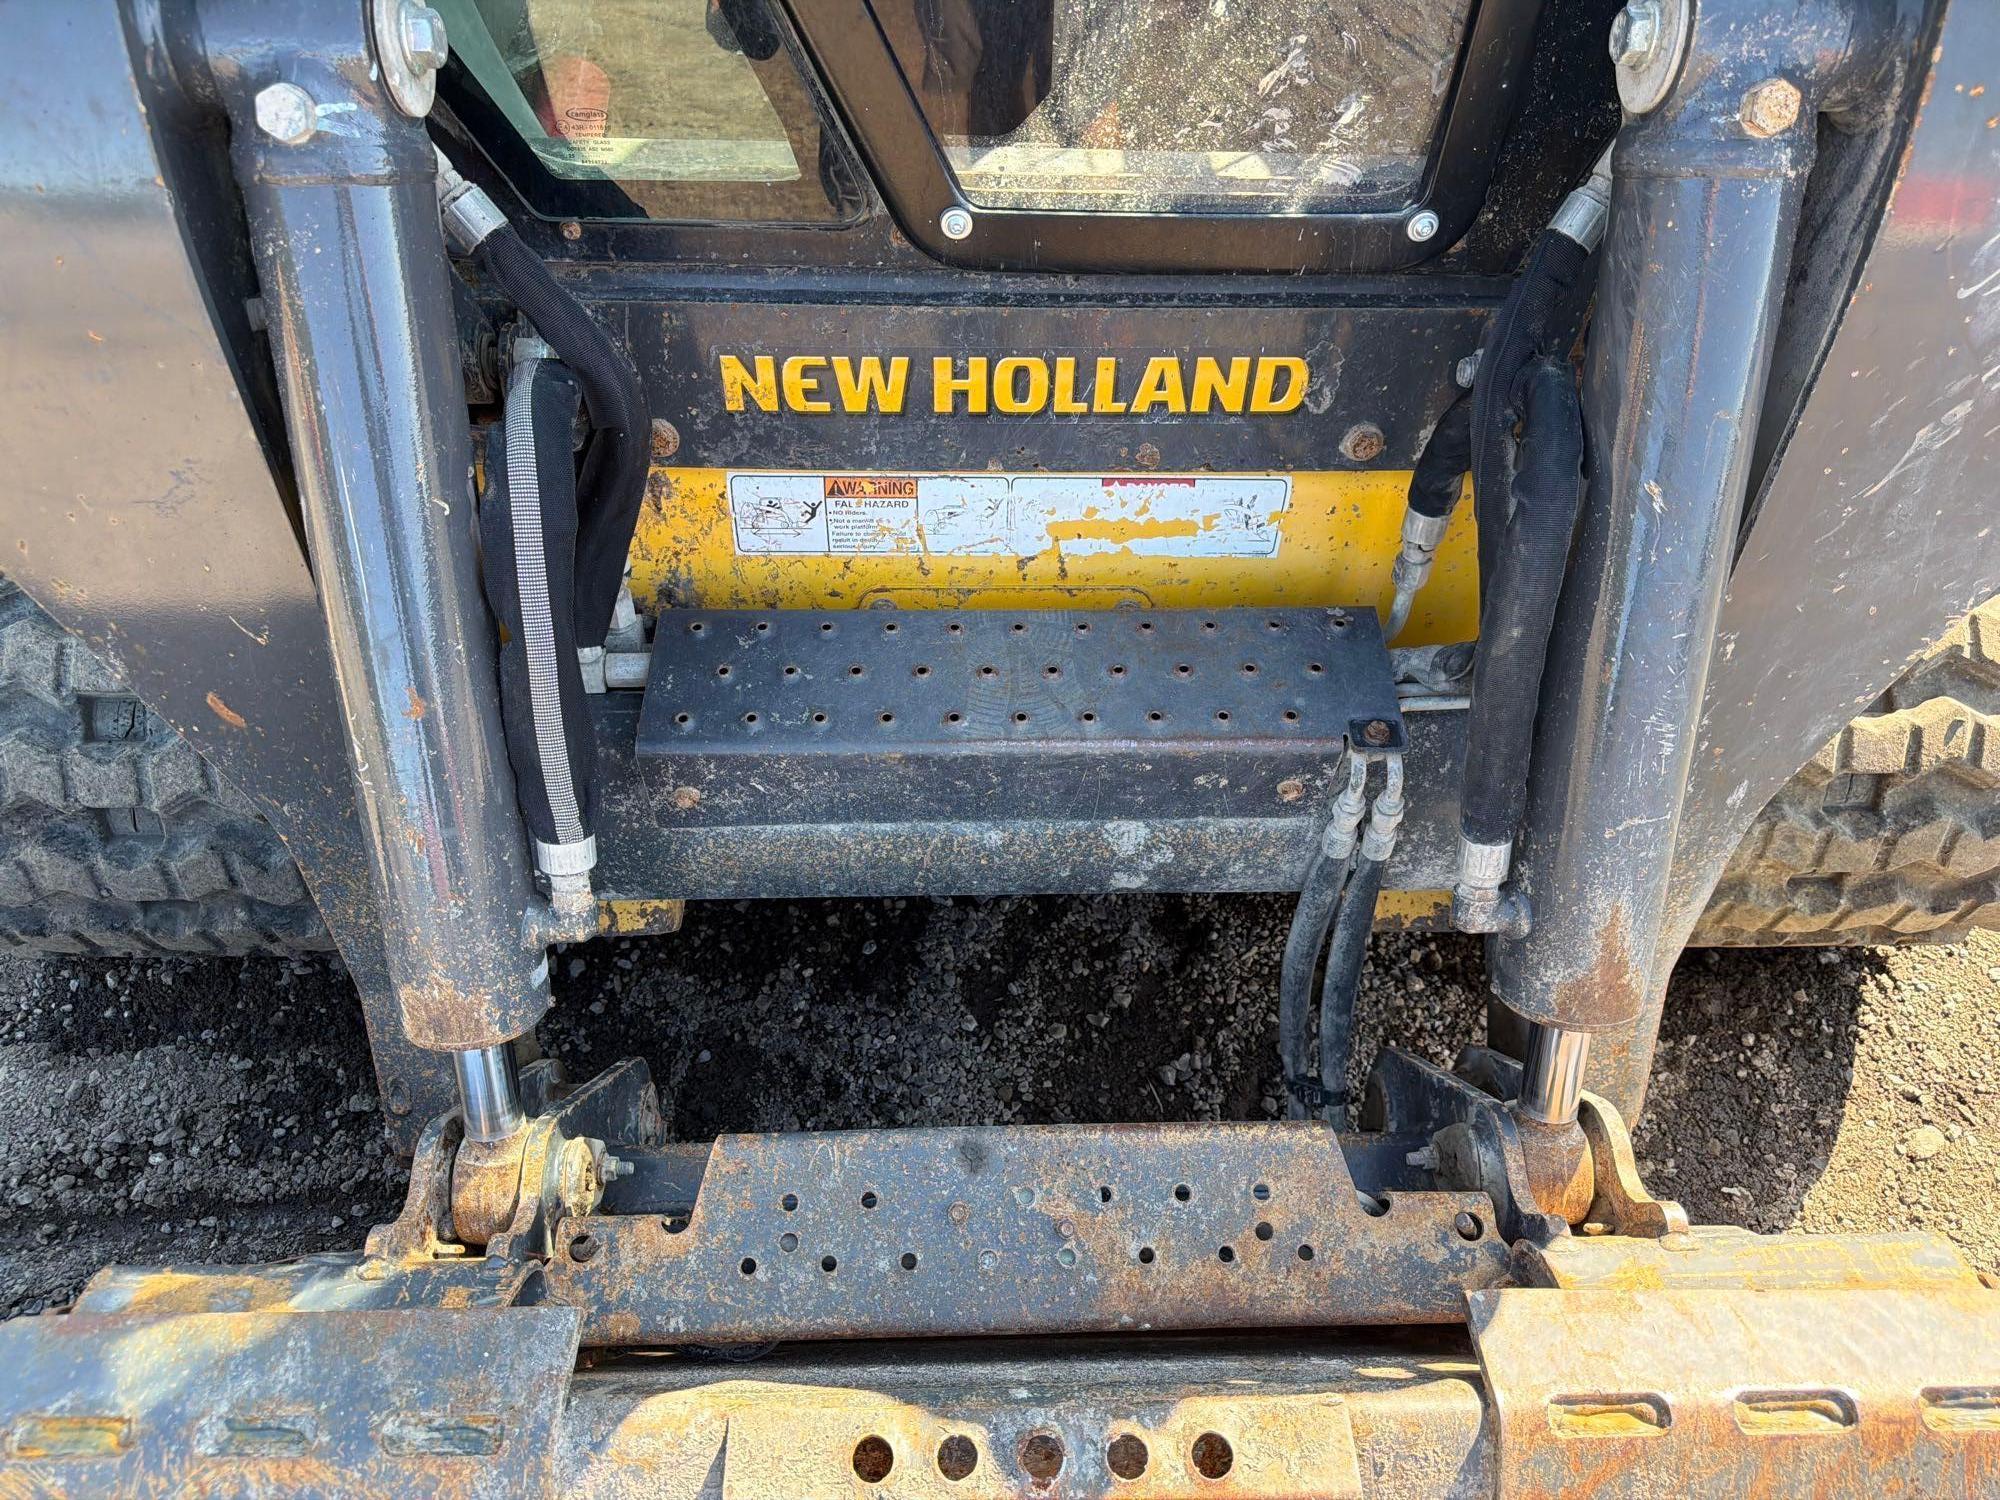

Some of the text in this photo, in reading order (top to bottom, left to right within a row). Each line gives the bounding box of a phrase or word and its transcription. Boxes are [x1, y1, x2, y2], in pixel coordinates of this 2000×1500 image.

[570, 110, 605, 119] camglass
[718, 355, 1310, 414] NEW HOLLAND
[834, 500, 909, 509] FAL HAZARD
